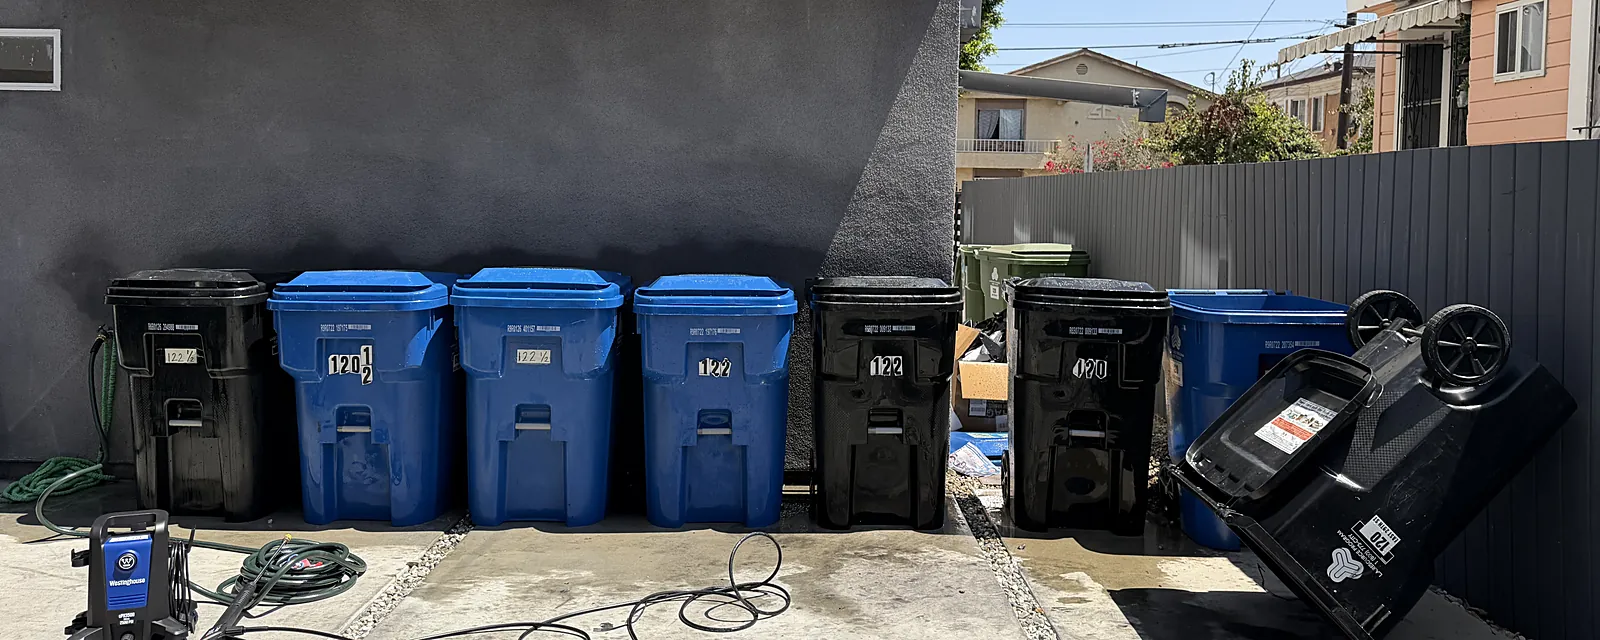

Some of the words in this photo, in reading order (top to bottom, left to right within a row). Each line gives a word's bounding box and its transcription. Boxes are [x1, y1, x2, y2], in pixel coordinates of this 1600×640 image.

[167, 352, 184, 362] 122
[330, 355, 360, 373] 120
[518, 351, 536, 361] 122
[701, 359, 730, 377] 122
[872, 356, 902, 375] 122
[1075, 358, 1106, 379] 120
[1337, 530, 1357, 551] PROGRAM
[1369, 531, 1390, 552] 120
[1387, 531, 1398, 542] EAST
[109, 578, 145, 587] Westinghouse
